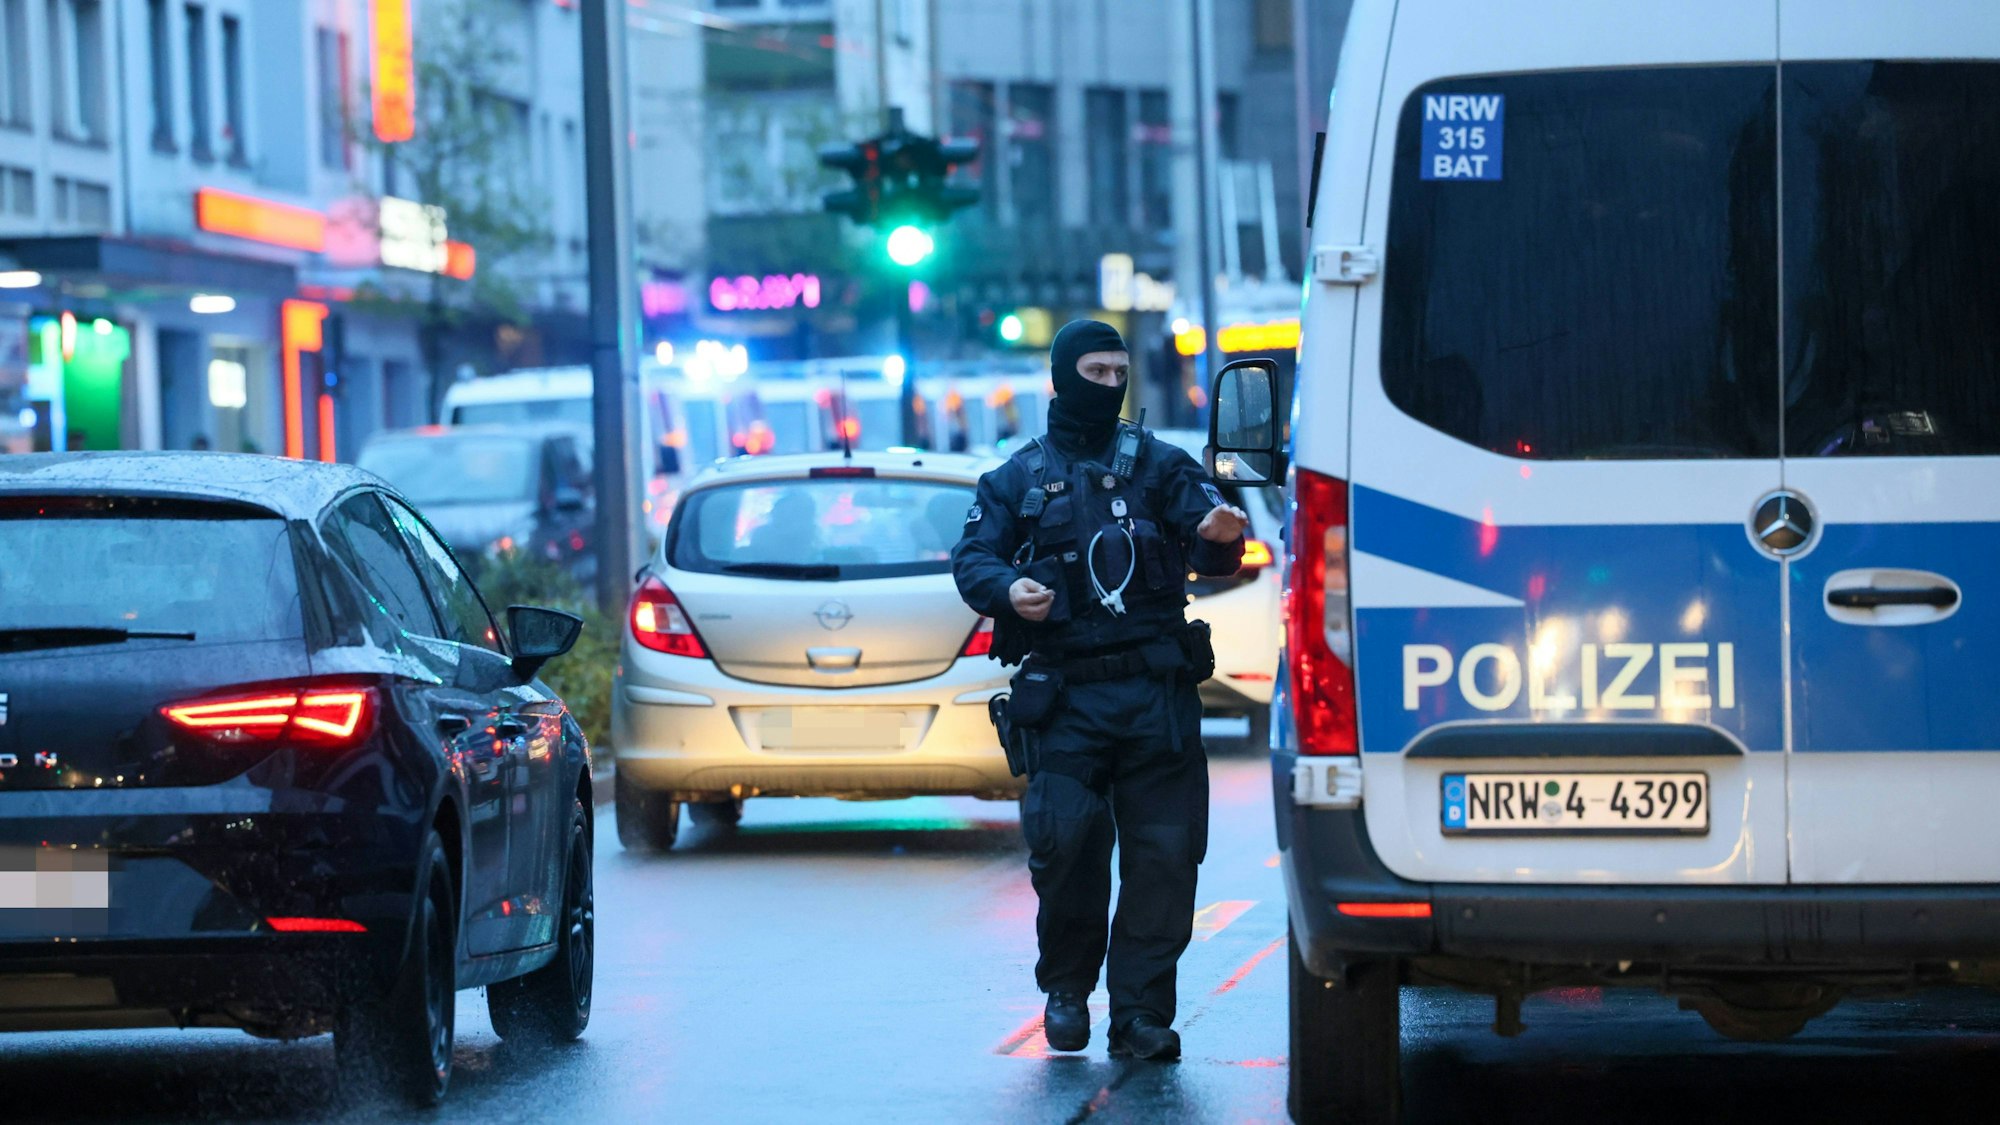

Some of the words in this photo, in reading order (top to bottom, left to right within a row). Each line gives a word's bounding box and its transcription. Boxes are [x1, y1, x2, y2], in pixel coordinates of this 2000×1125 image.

[1426, 95, 1500, 121] NRW
[1438, 127, 1486, 150] 315
[1433, 154, 1489, 178] BAT
[1402, 642, 1735, 711] POLIZEI
[1449, 806, 1461, 821] D
[1469, 782, 1540, 820] NRW
